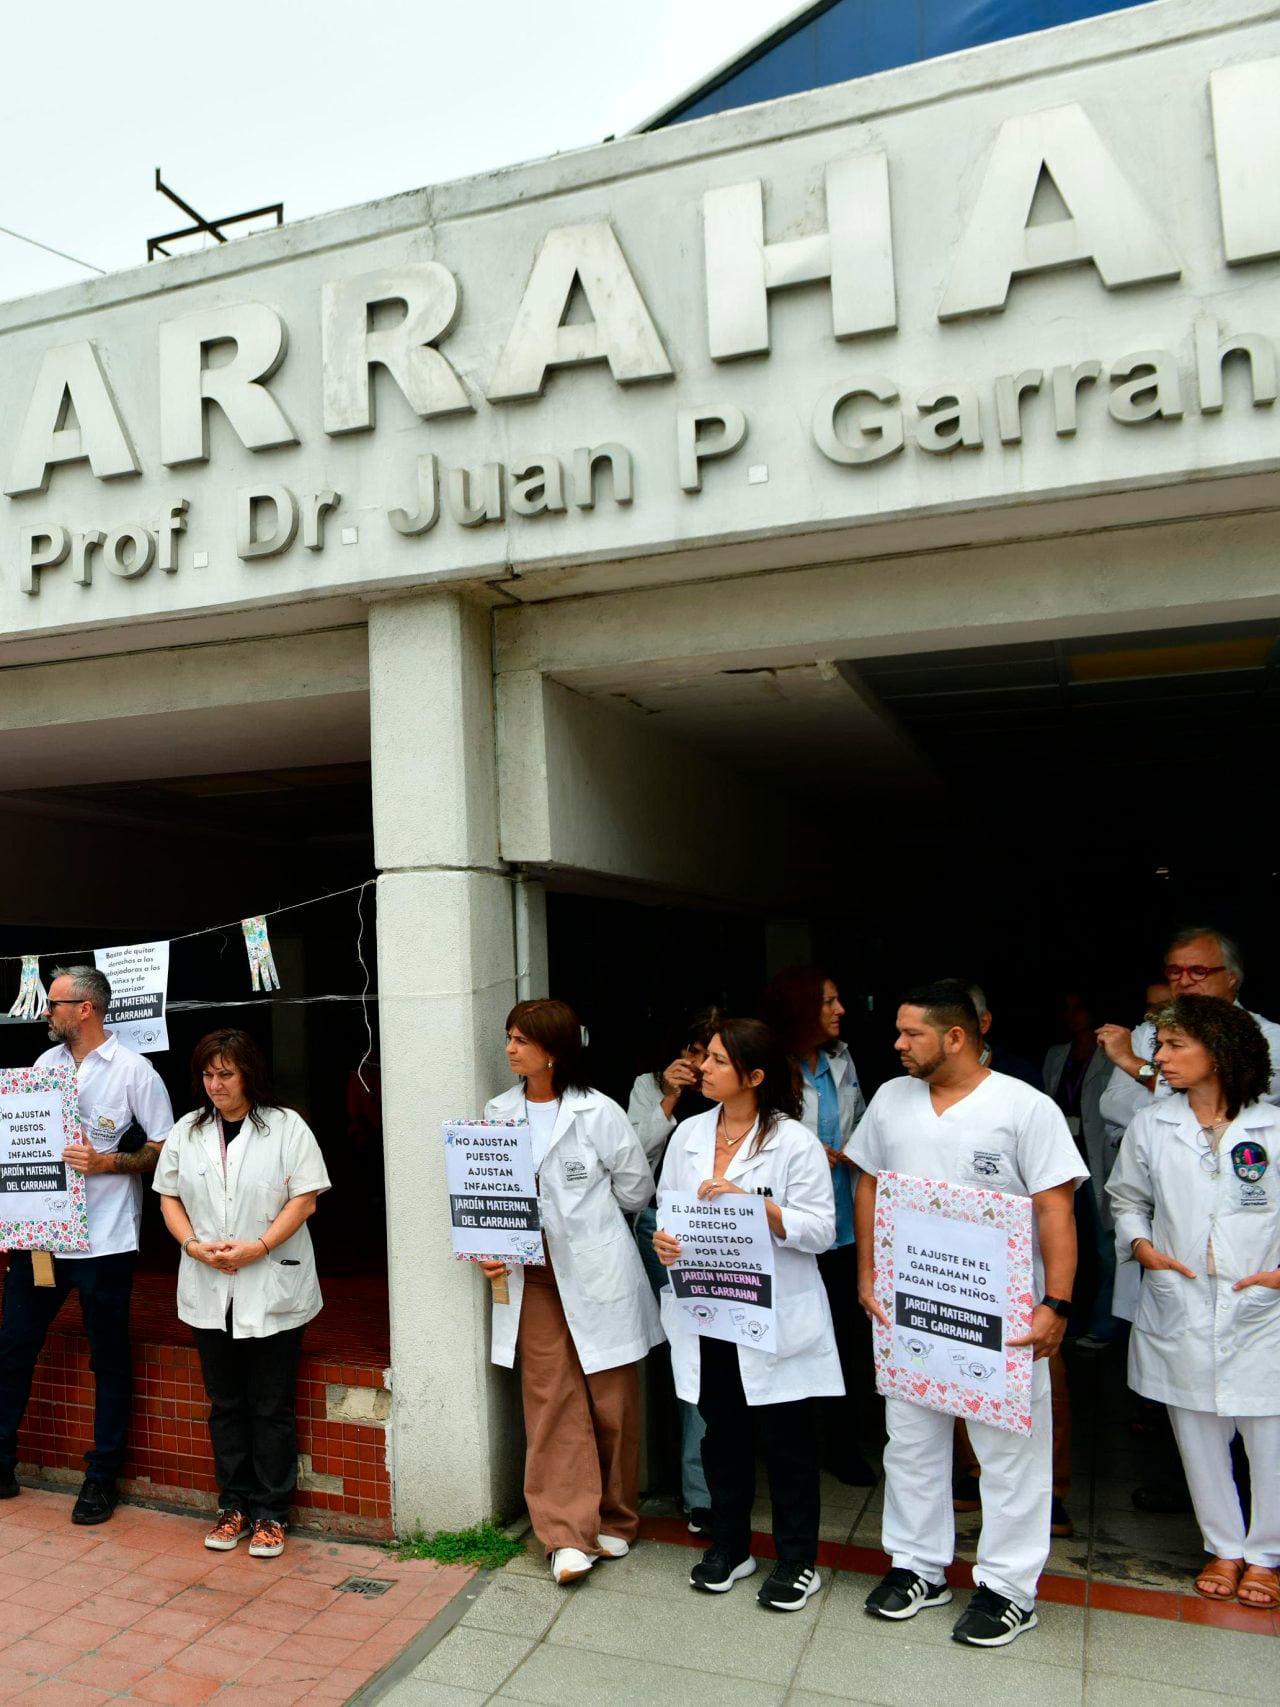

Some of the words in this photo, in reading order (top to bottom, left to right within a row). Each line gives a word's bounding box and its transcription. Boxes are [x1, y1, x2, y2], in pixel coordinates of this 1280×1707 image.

[20, 499, 209, 595] Prof.
[236, 483, 359, 561] Dr.
[387, 441, 634, 536] Juan
[675, 402, 770, 494] P.
[122, 994, 158, 1007] MATERNAL
[104, 1015, 114, 1023] EL
[115, 1008, 153, 1021] GARRAHAN
[2, 1111, 13, 1120] NO
[15, 1110, 51, 1120] AJUSTAN
[10, 1123, 46, 1133] PUESTOS.
[11, 1137, 47, 1146] AJUSTAN
[455, 1138, 470, 1146] NO
[473, 1138, 518, 1147] AJUSTAN
[8, 1150, 55, 1160] INFANCIAS.
[466, 1152, 512, 1162] PUESTOS.
[1, 1164, 25, 1178] JARDÍN
[26, 1165, 62, 1176] MATERNAL
[468, 1168, 513, 1177] AJUSTAN
[6, 1181, 19, 1191] DEL
[20, 1180, 58, 1191] GARRAHAN
[464, 1182, 523, 1192] INFANCIAS.
[455, 1197, 484, 1211] JARDÍN
[486, 1200, 532, 1212] MATERNAL
[672, 1204, 682, 1213] EL
[684, 1204, 721, 1215] JARDÍN
[724, 1207, 736, 1216] ES
[738, 1208, 754, 1217] UN
[461, 1215, 478, 1226] DEL
[479, 1215, 528, 1229] GARRAHAN
[688, 1220, 737, 1230] DERECHO
[675, 1233, 754, 1244] CONQUISTADO
[695, 1248, 718, 1256] POR
[720, 1248, 741, 1257] LAS
[907, 1245, 918, 1255] EL
[920, 1249, 959, 1265] AJUSTE
[962, 1257, 976, 1268] EN
[979, 1262, 991, 1272] EL
[677, 1259, 762, 1271] TRABAJADORAS
[681, 1269, 715, 1283] JARDÍN
[715, 1272, 763, 1287] MATERNAL
[910, 1260, 970, 1282] GARRAHAN
[972, 1274, 987, 1286] LO
[690, 1285, 709, 1295] DEL
[710, 1286, 758, 1302] GARRAHAN
[898, 1272, 934, 1288] PAGAN
[937, 1281, 957, 1293] LOS
[960, 1286, 999, 1304] NIÑOS.
[904, 1297, 938, 1315] JARDÍN
[939, 1305, 990, 1328] MATERNAL
[910, 1314, 929, 1329] DEL
[930, 1320, 983, 1344] GARRAHAN
